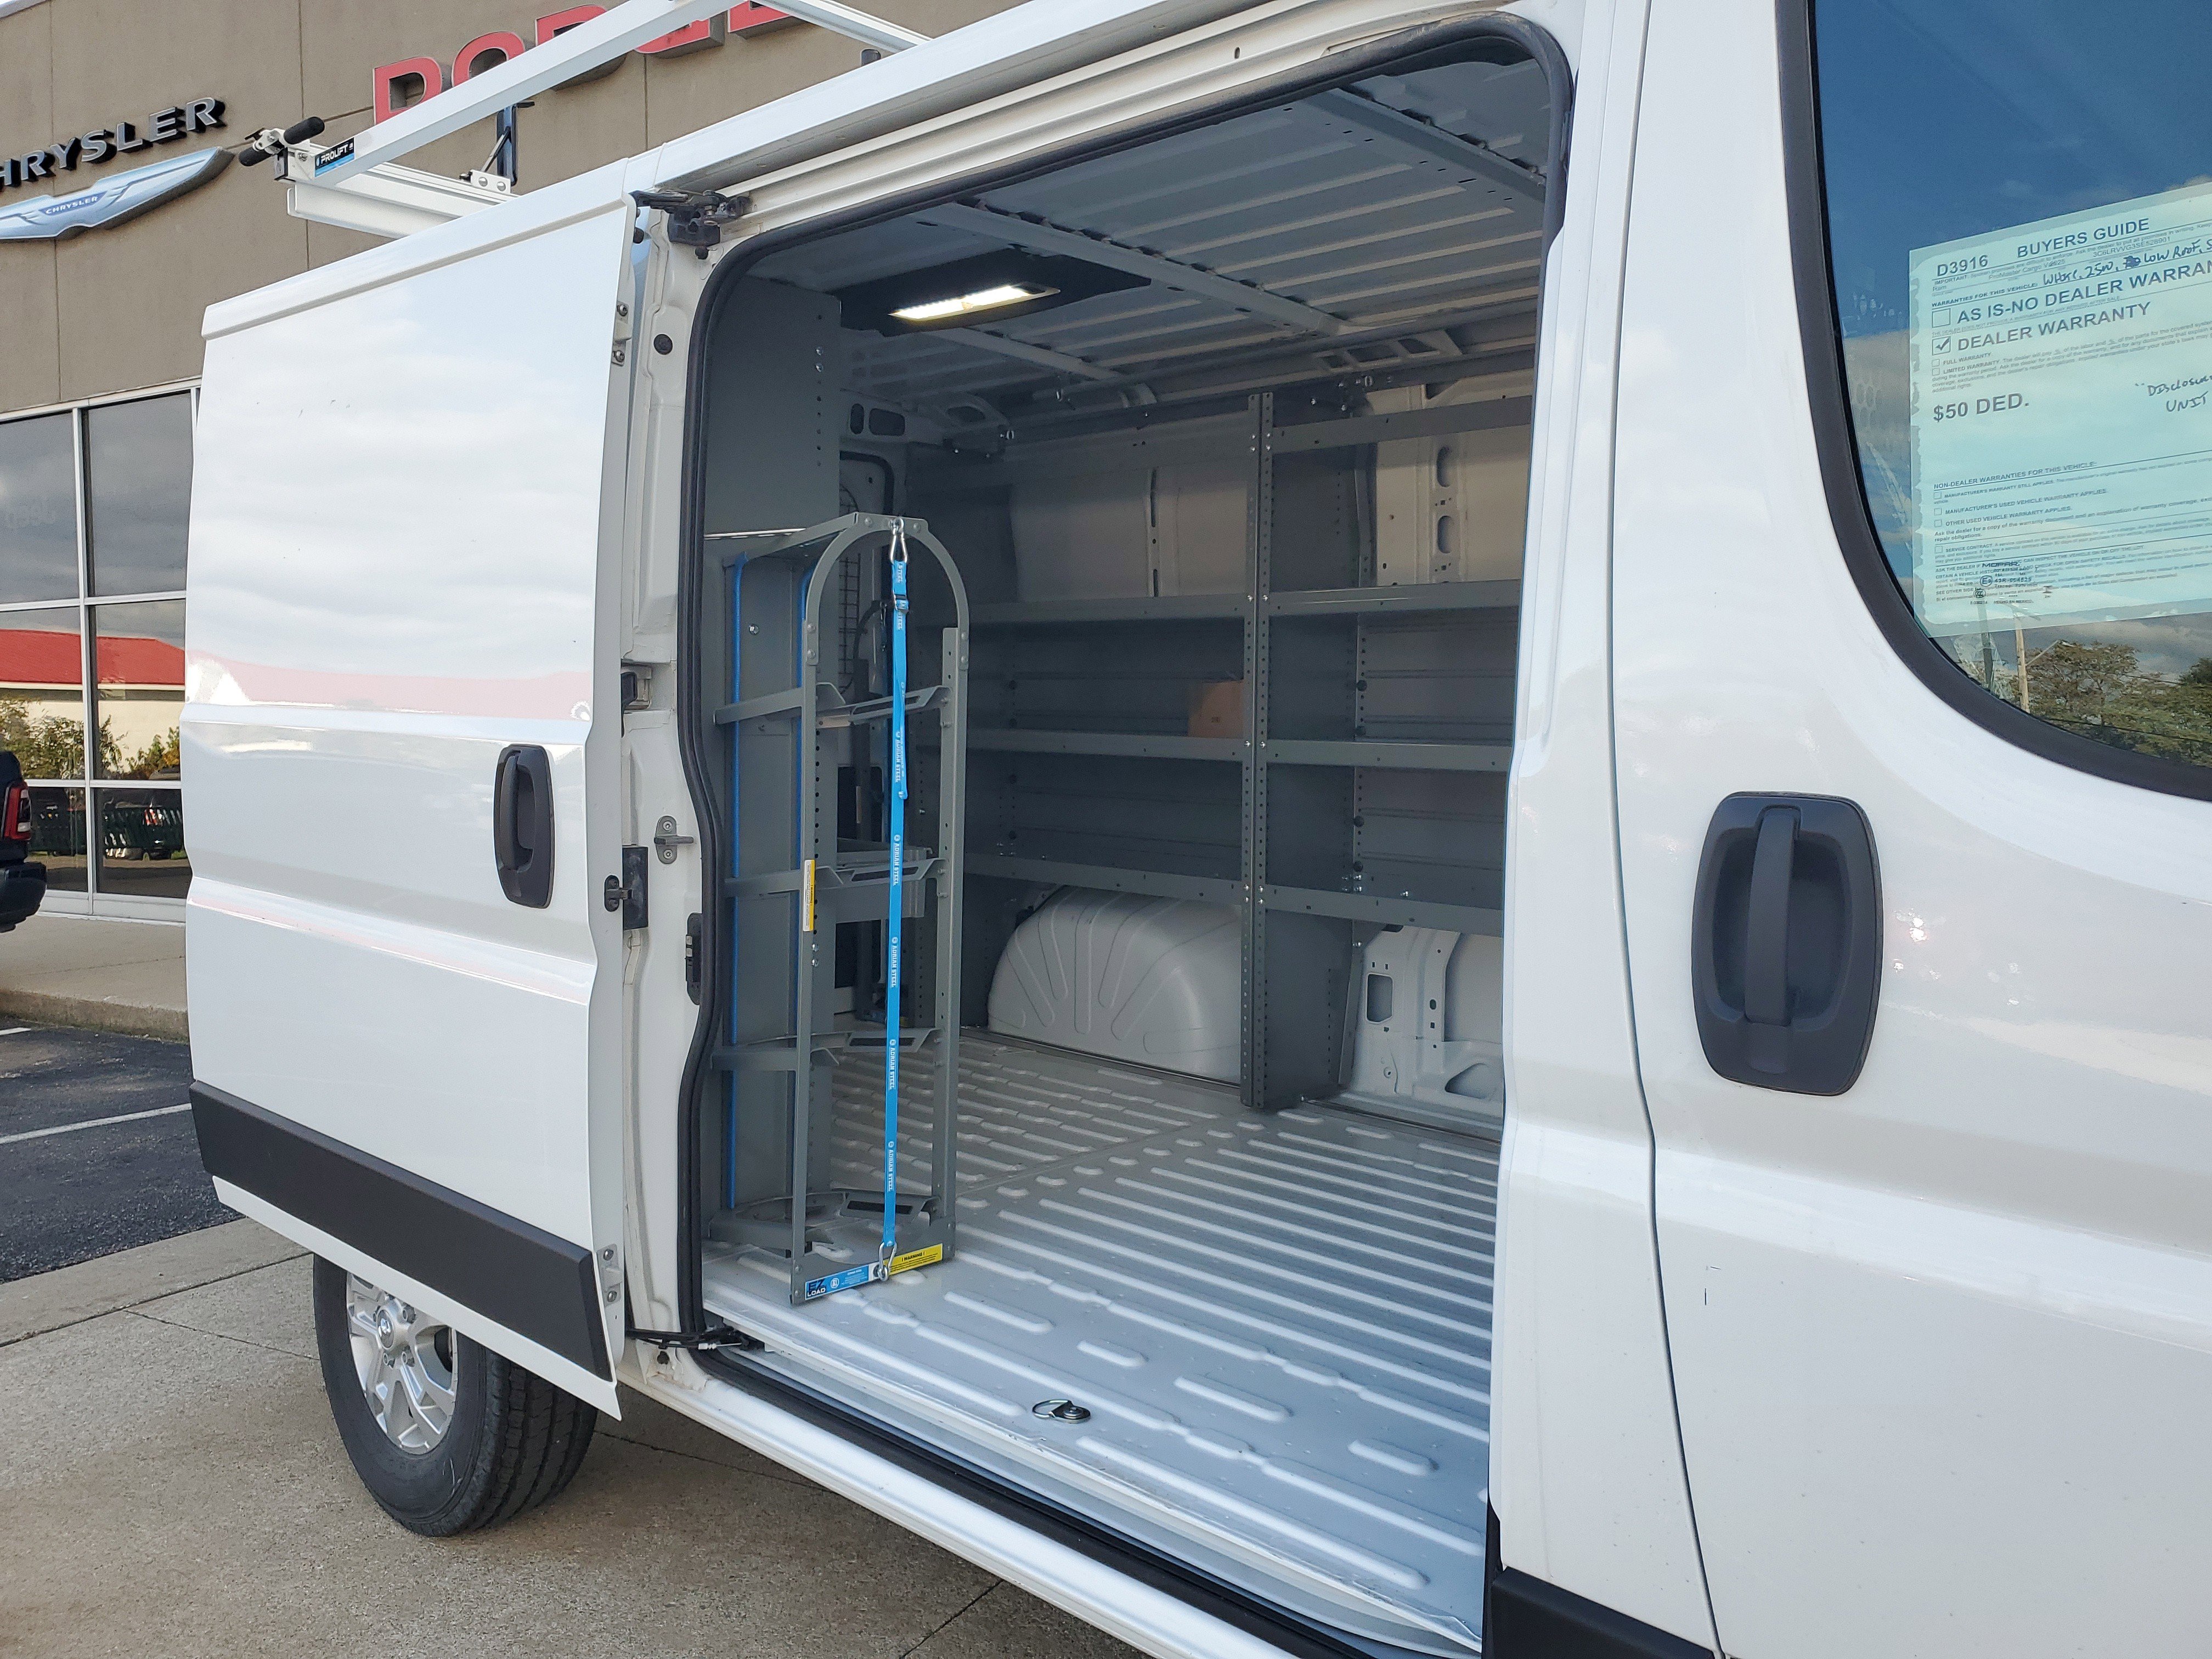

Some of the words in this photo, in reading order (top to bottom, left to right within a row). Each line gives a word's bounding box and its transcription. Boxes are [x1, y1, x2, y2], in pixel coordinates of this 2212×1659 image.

[321, 144, 349, 165] PROLIFT
[46, 195, 98, 215] CHRYSLER
[2017, 231, 2087, 258] BUYERS
[2093, 217, 2149, 241] GUIDE
[1937, 253, 1988, 277] D3916
[1931, 295, 1973, 308] WARRANTIES
[1957, 306, 1982, 324] AS
[1988, 295, 2038, 318] IS-NO
[2045, 278, 2123, 306] DEALER
[1958, 325, 2032, 351] DEALER
[2038, 301, 2151, 335] WARRANTY
[1933, 400, 1968, 423] $50
[1976, 390, 2029, 415] DED.
[2166, 391, 2209, 412] UNIT
[1934, 478, 1977, 489] NON-DEALER
[1979, 471, 2025, 483] WARRANTIES
[1945, 503, 1997, 515] MANUFACTURER'S
[807, 1287, 826, 1297] LOAD
[808, 1278, 826, 1290] EZ
